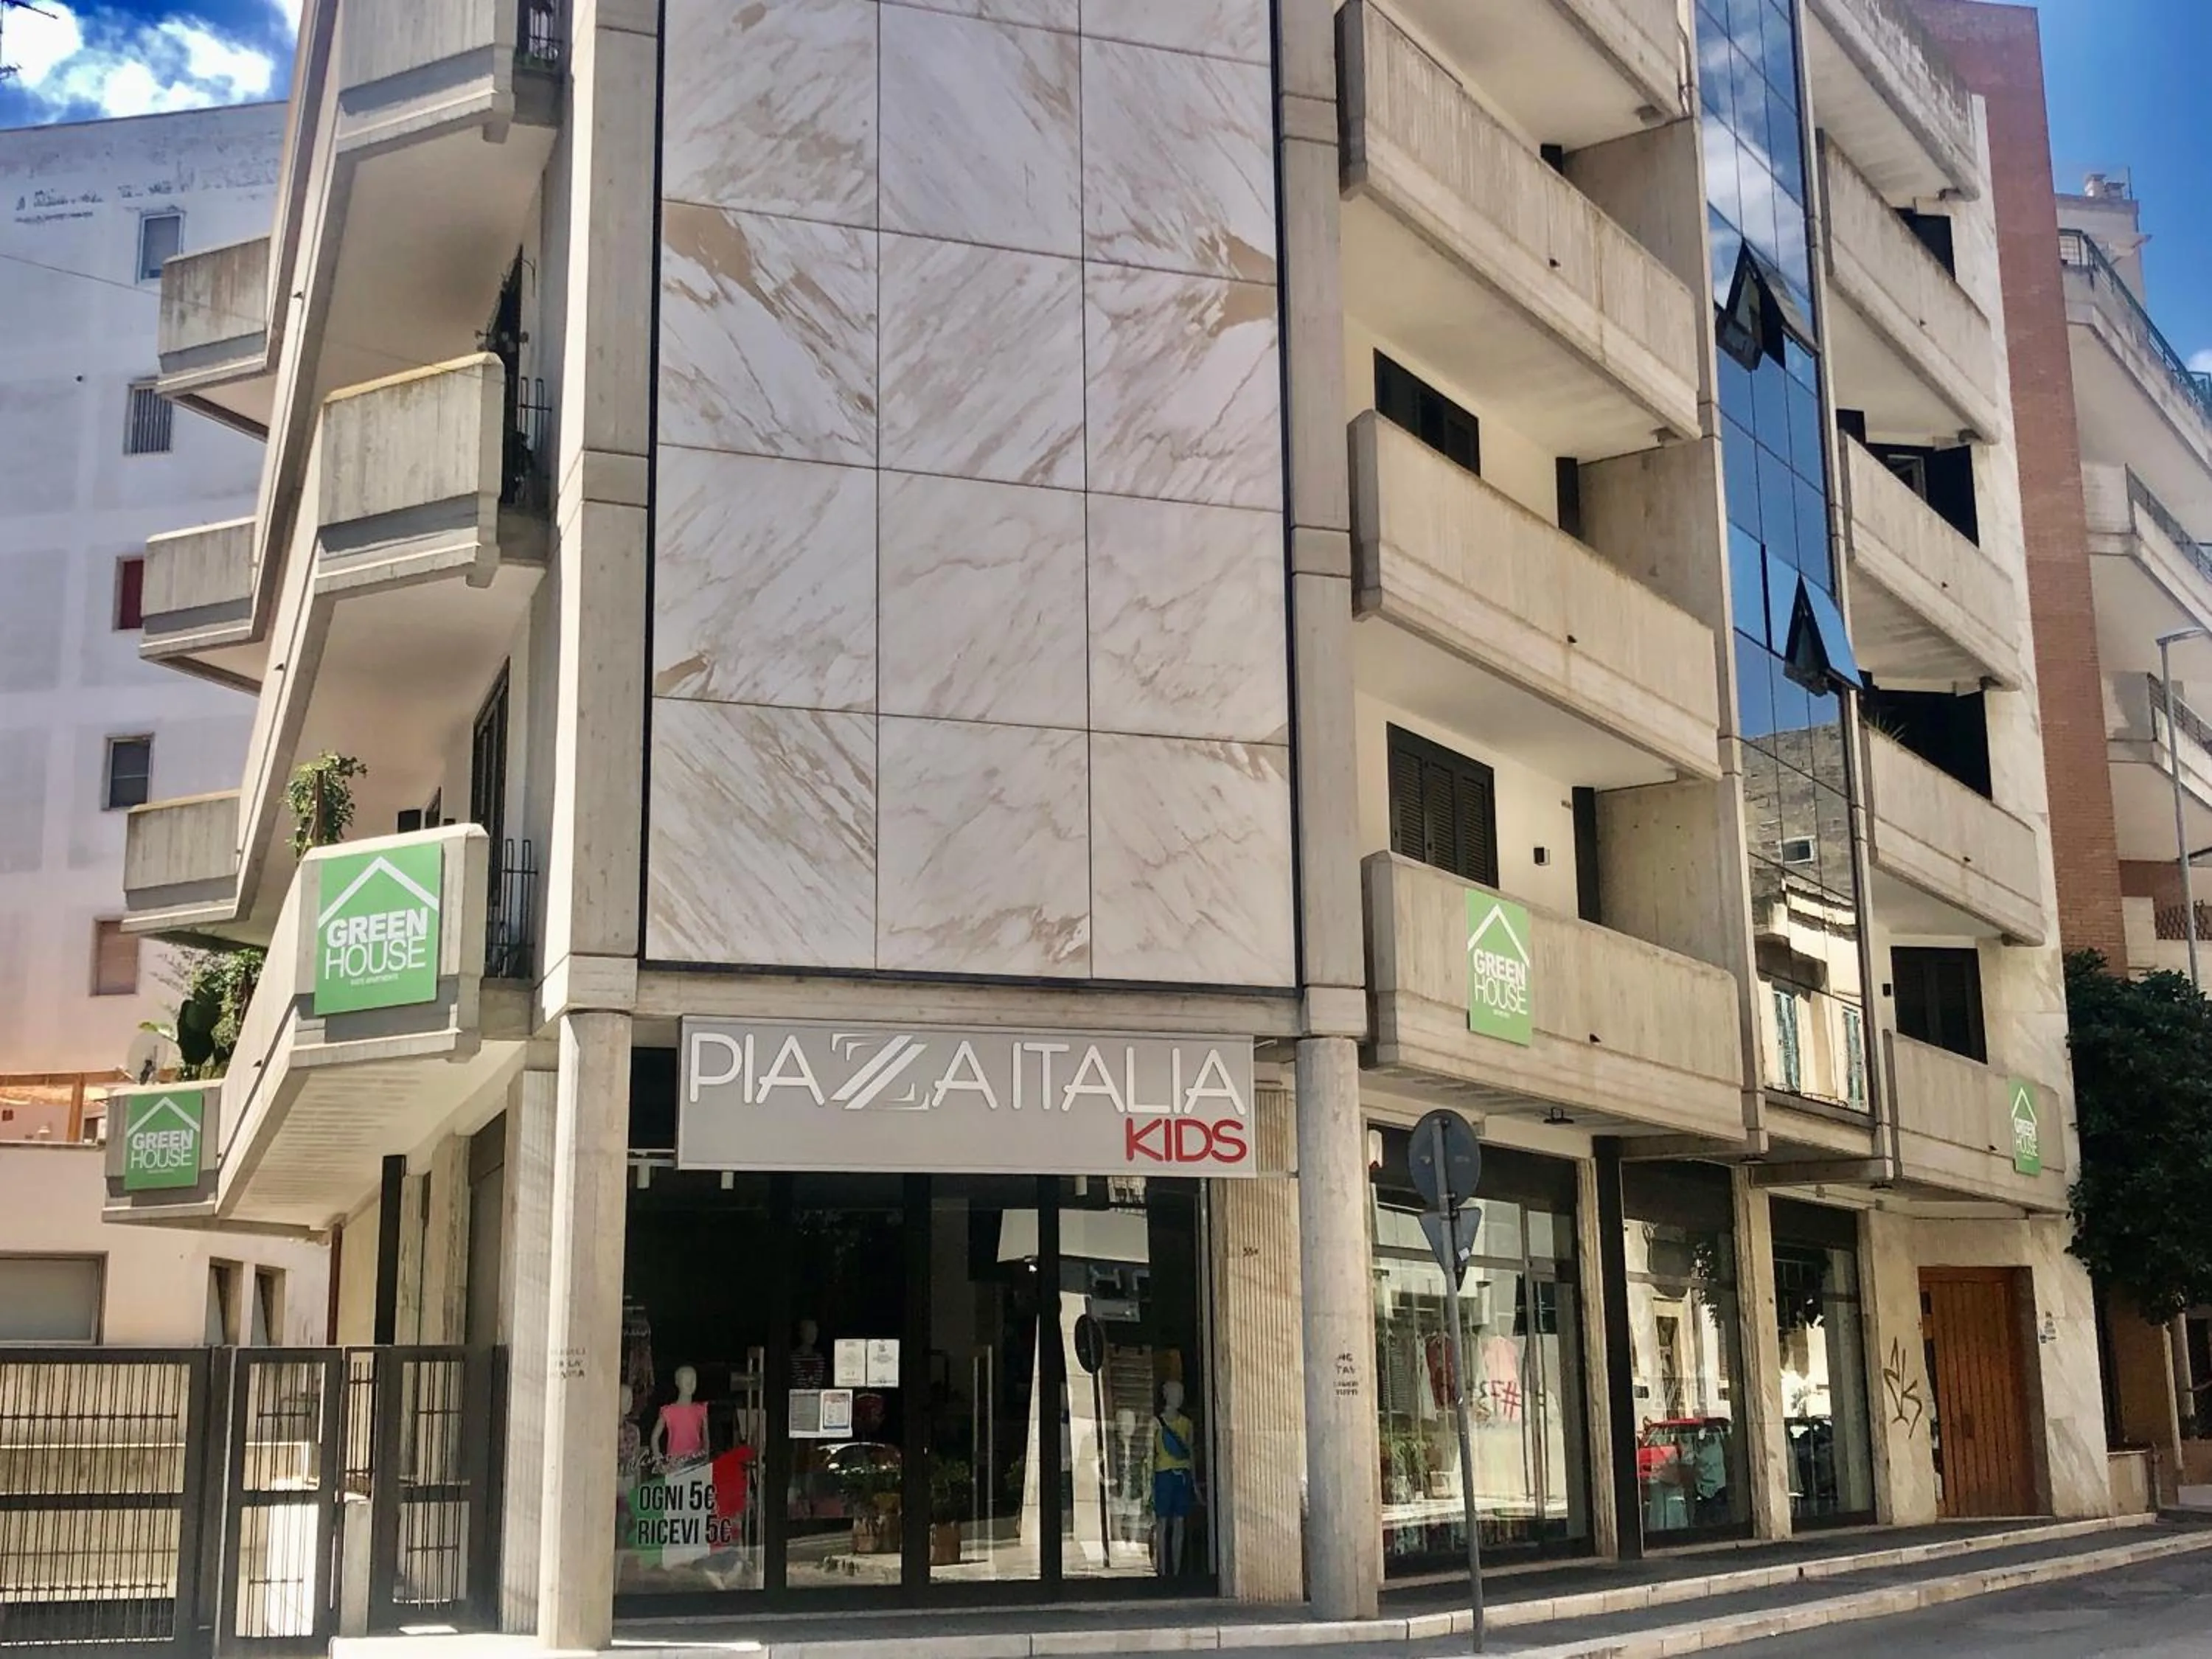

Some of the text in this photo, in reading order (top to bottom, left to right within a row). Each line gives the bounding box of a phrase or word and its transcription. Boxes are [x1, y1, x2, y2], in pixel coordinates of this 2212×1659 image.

[327, 907, 428, 947] GREEN
[324, 936, 425, 980] HOUSE
[1473, 949, 1526, 987] GREEN
[1475, 973, 1528, 1015] HOUSE
[1012, 1041, 1246, 1115] ITALIA
[131, 1147, 192, 1169] HOUSE
[132, 1130, 194, 1150] GREEN
[1125, 1117, 1247, 1163] KIDS
[2016, 1133, 2038, 1156] HOUSE
[639, 1481, 715, 1510] OGNI 5€
[638, 1514, 731, 1544] RICEVI 5€
